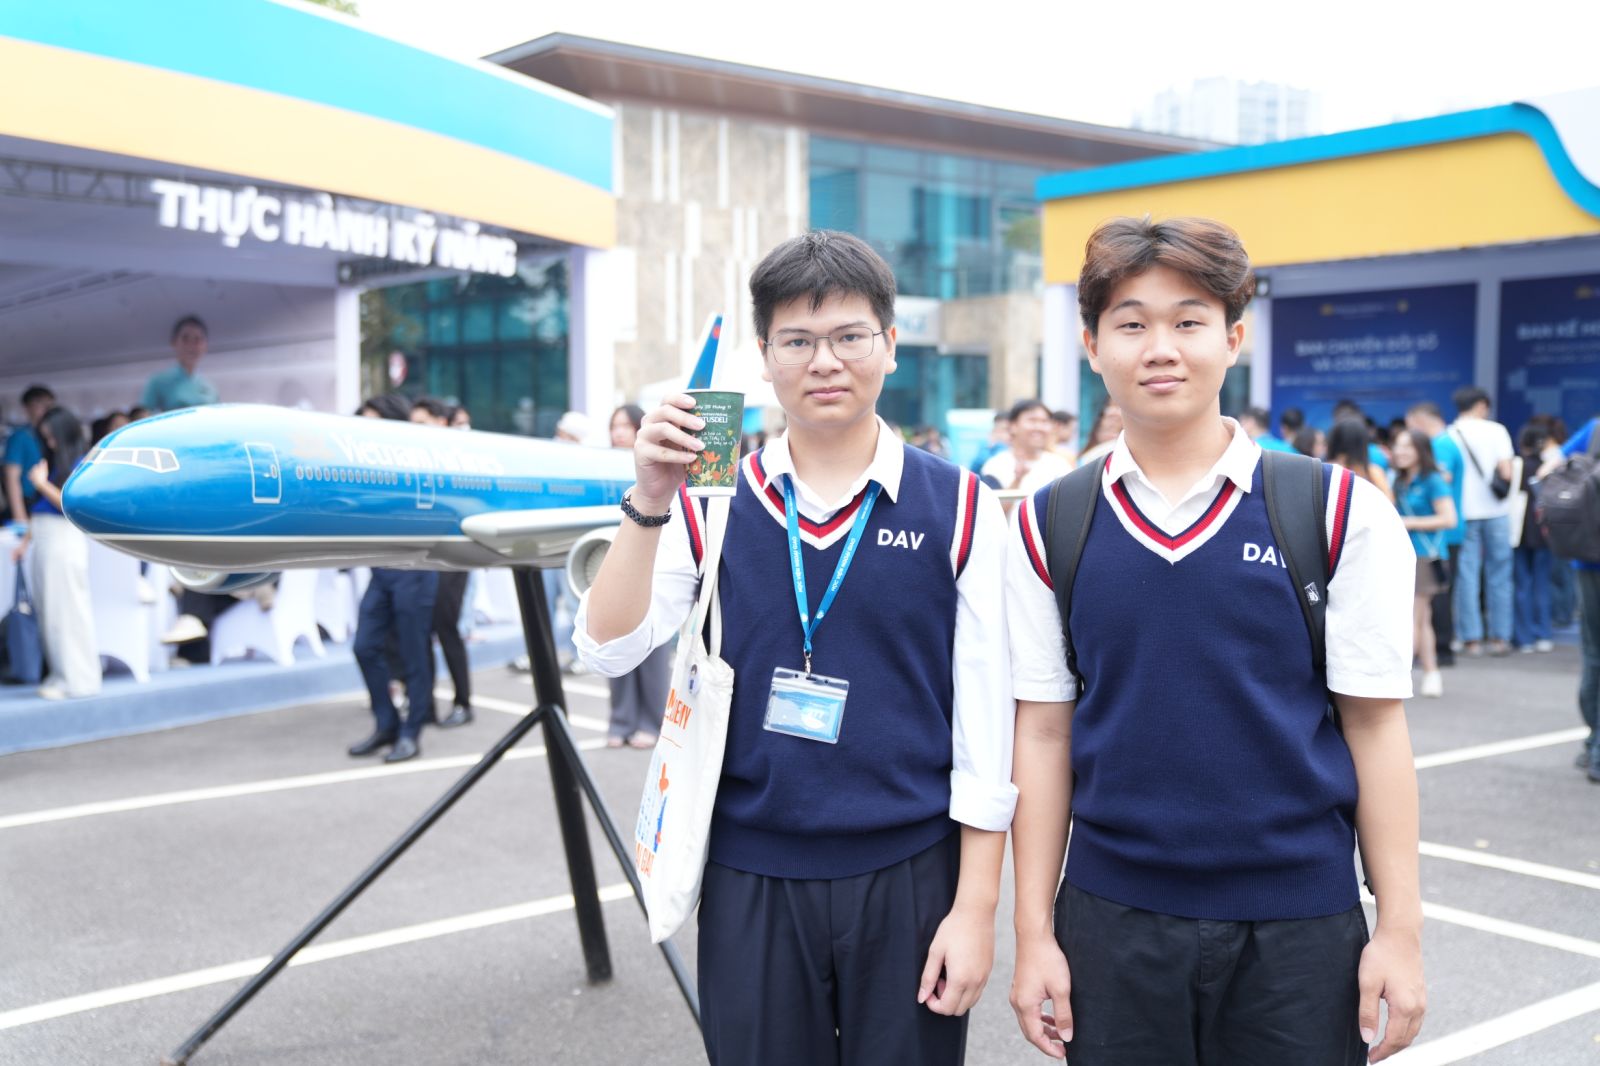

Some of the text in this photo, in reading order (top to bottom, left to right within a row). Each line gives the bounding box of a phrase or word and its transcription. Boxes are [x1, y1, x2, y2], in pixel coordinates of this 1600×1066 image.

[150, 179, 280, 249] THỰC
[283, 192, 389, 259] HÀNH
[390, 212, 437, 265] KỸ
[877, 528, 924, 550] DAV
